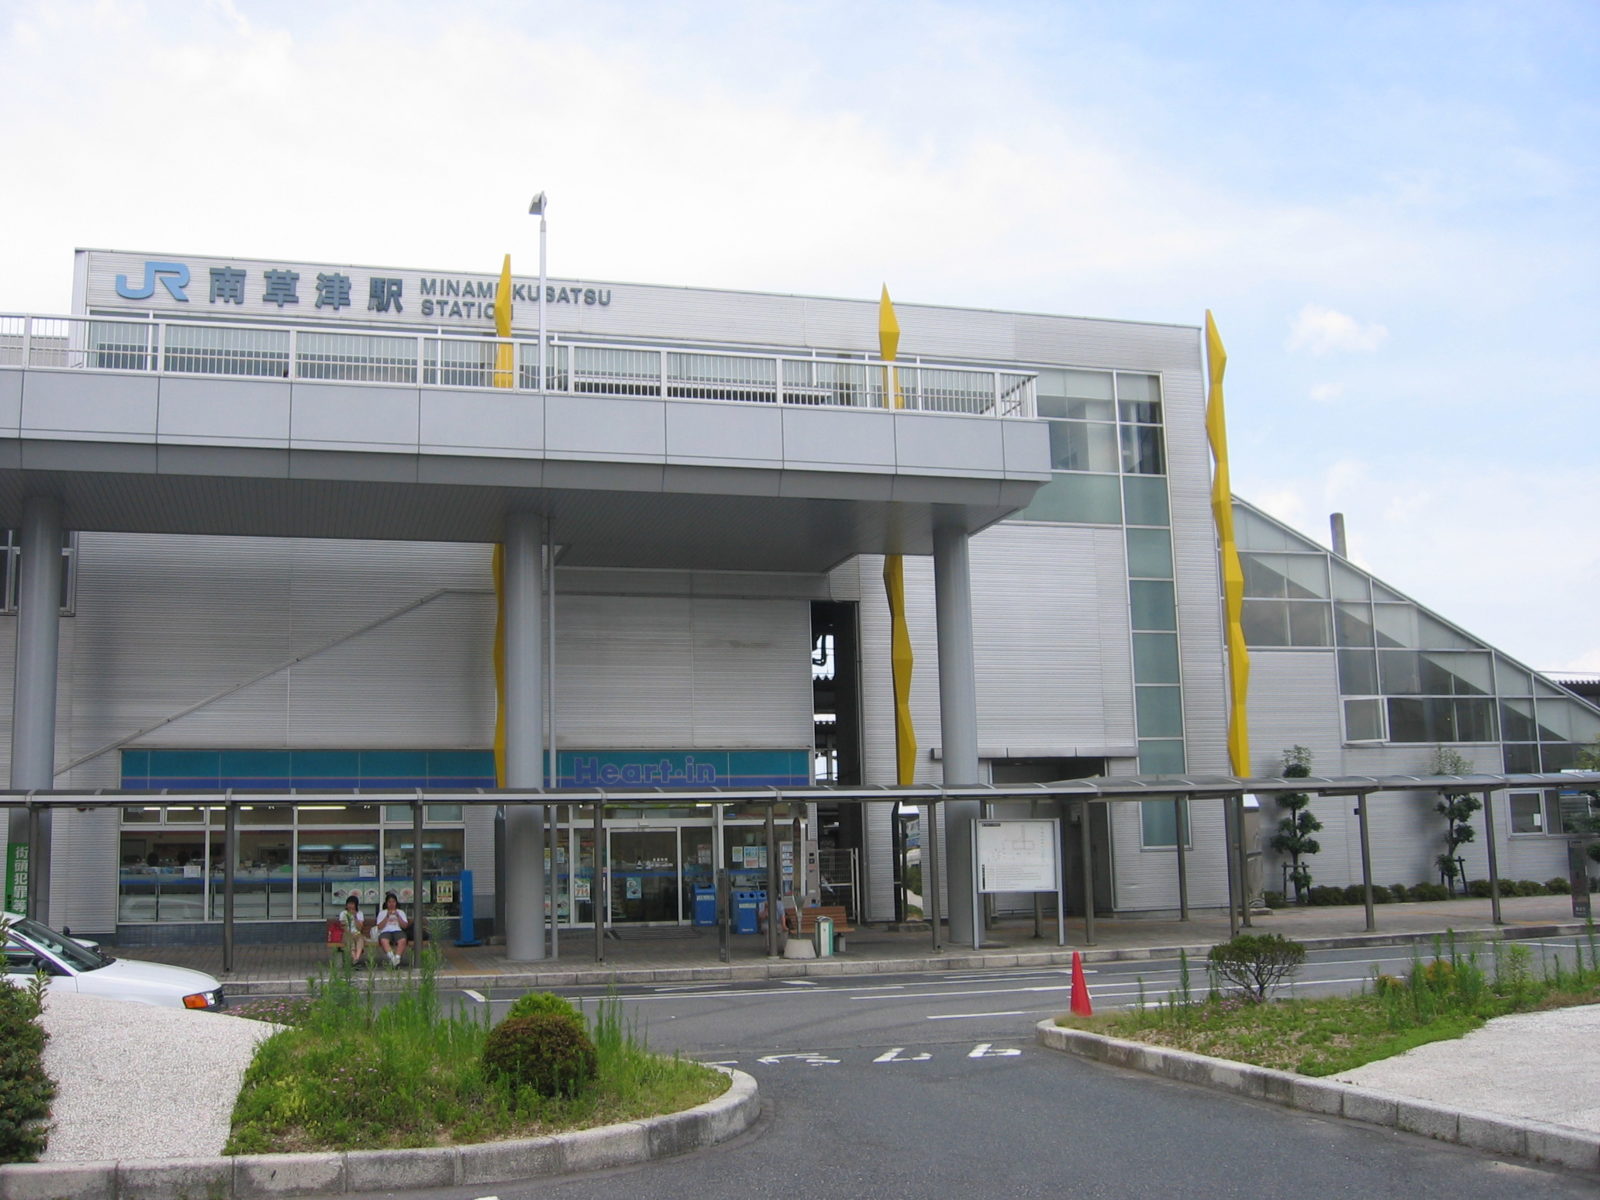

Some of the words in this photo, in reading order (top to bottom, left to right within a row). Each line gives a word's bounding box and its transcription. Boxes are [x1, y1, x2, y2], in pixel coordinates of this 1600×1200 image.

[115, 261, 191, 302] JR
[208, 265, 404, 313] 南草津駅
[512, 283, 612, 306] KUSATSU
[420, 298, 514, 321] STATIO
